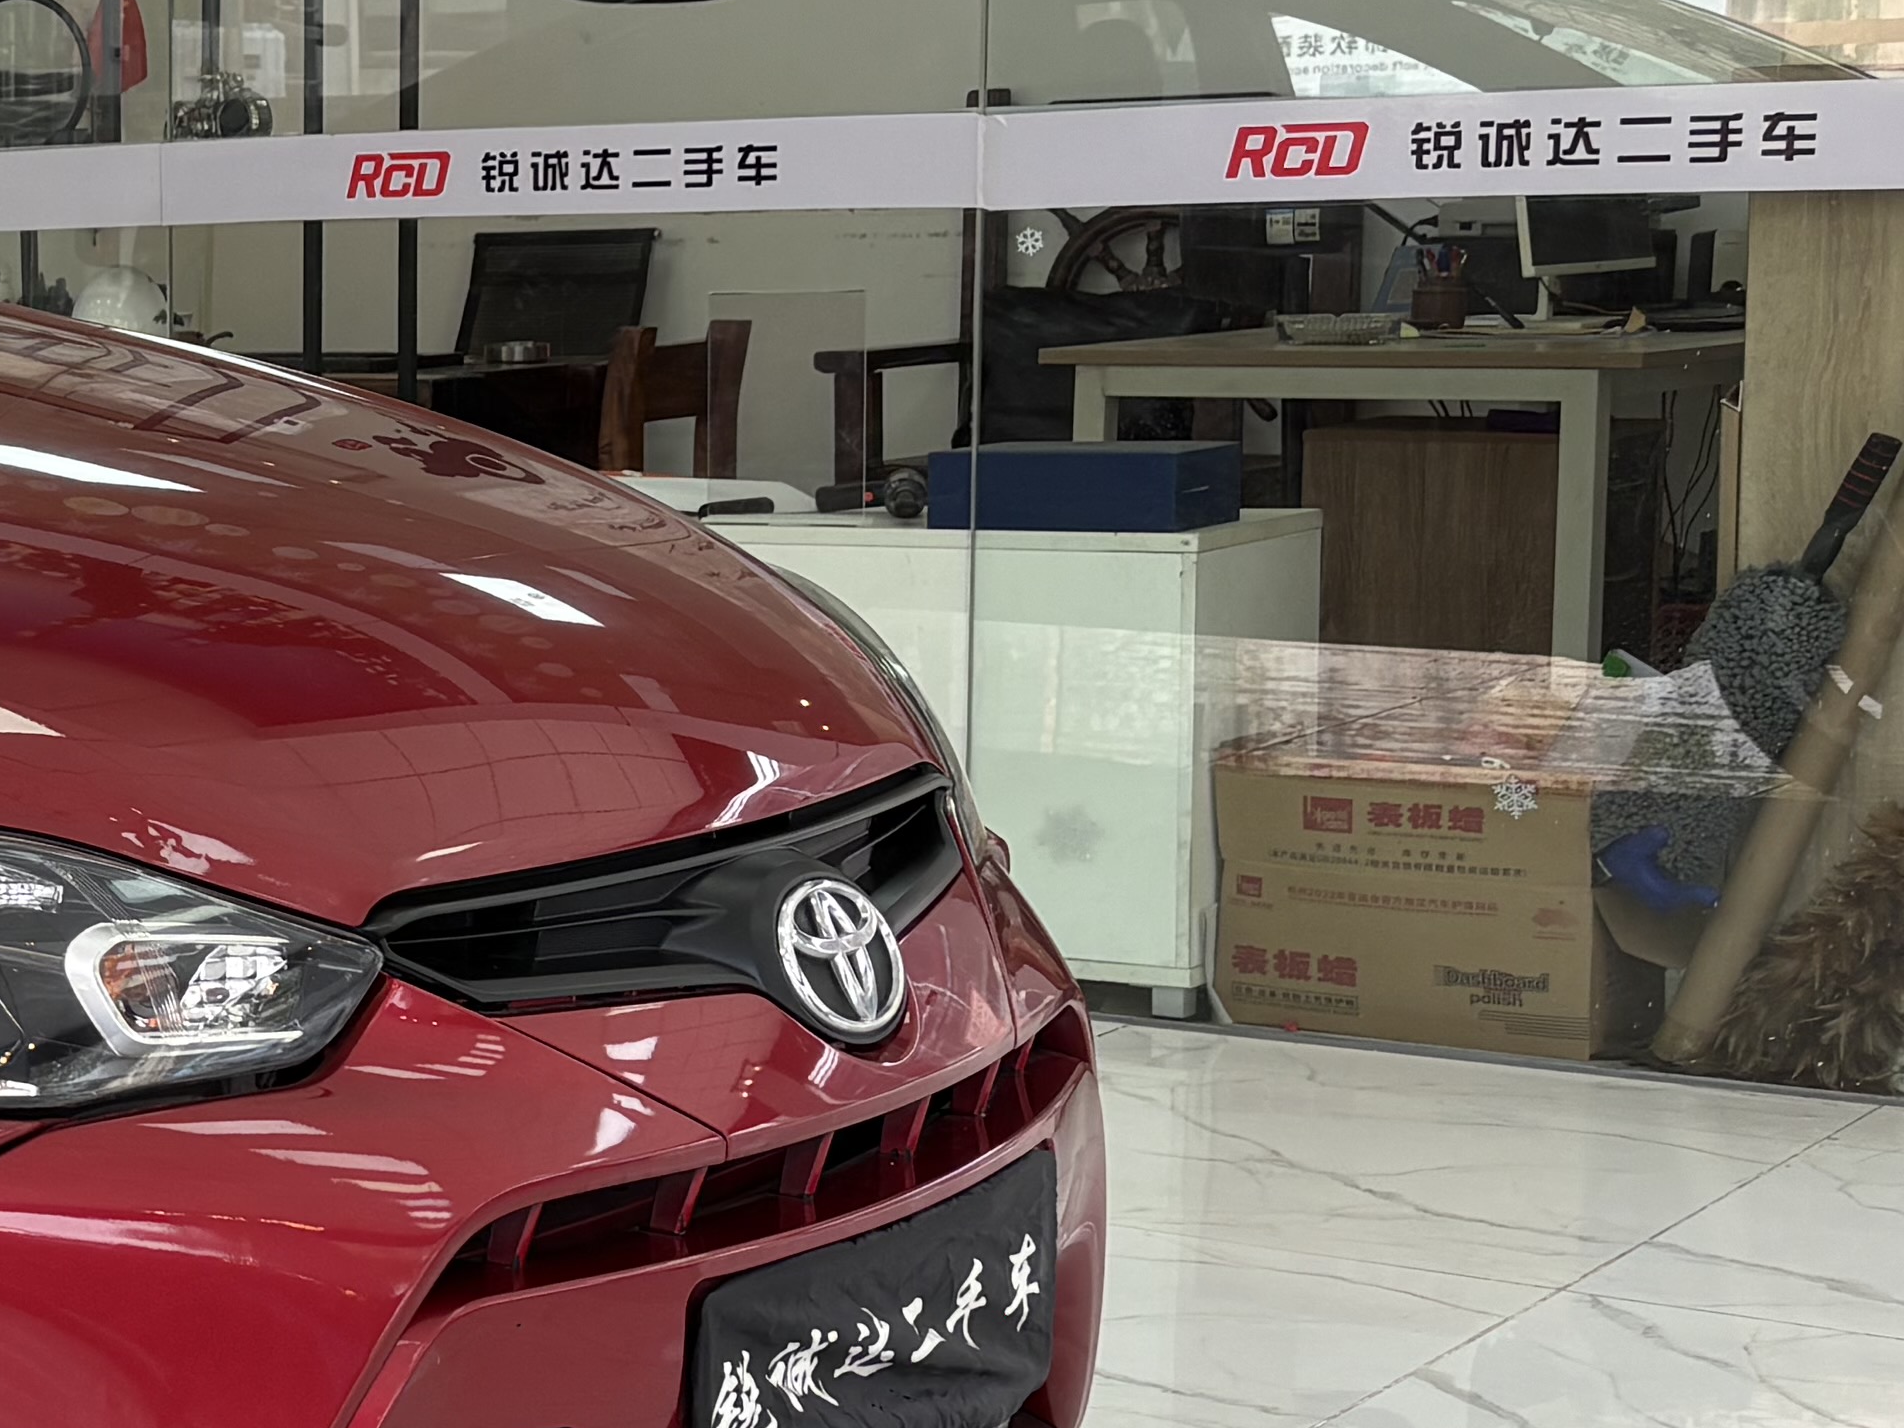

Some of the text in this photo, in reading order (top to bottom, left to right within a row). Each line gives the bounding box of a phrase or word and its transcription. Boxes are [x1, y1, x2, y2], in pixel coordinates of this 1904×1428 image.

[480, 142, 779, 195] 锐诚达二手车
[1409, 110, 1820, 174] 锐诚达二手车
[1469, 991, 1525, 1009] polish
